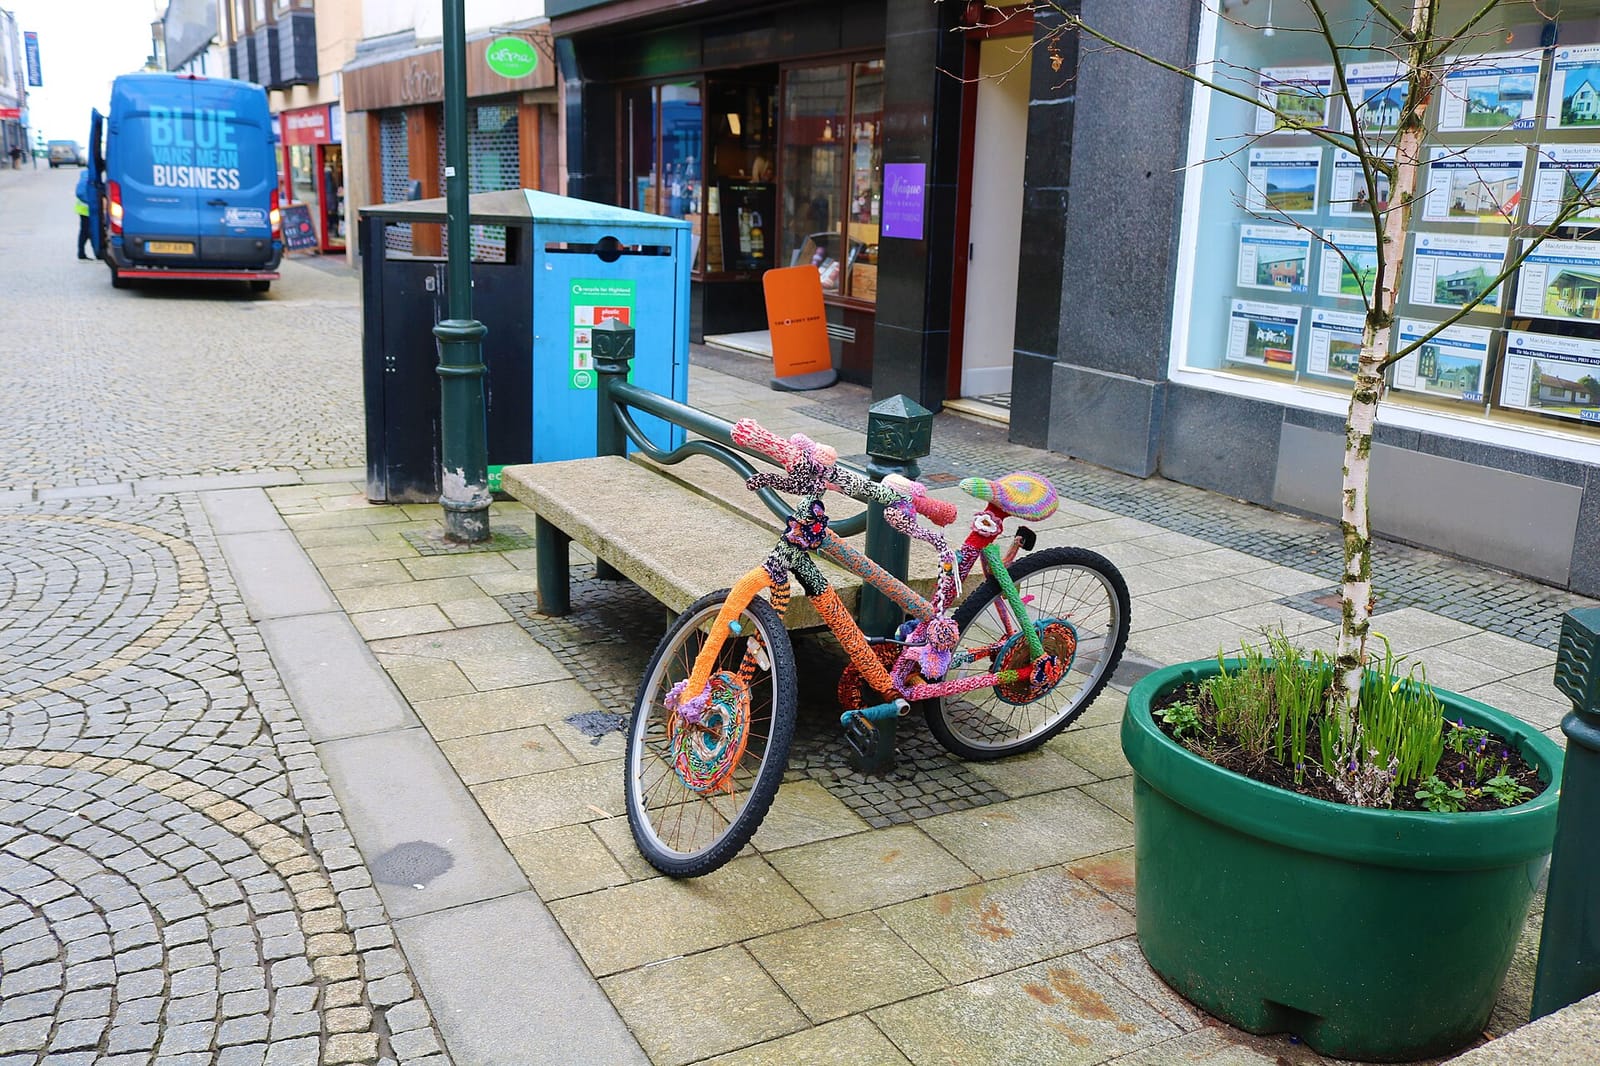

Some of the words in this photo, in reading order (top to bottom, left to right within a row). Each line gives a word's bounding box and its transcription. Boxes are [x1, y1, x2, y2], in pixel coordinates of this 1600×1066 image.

[149, 105, 238, 150] BLUE
[1513, 120, 1535, 129] SOLD
[152, 147, 192, 167] VANS
[196, 148, 239, 169] MEAN
[153, 164, 240, 190] BUSINESS
